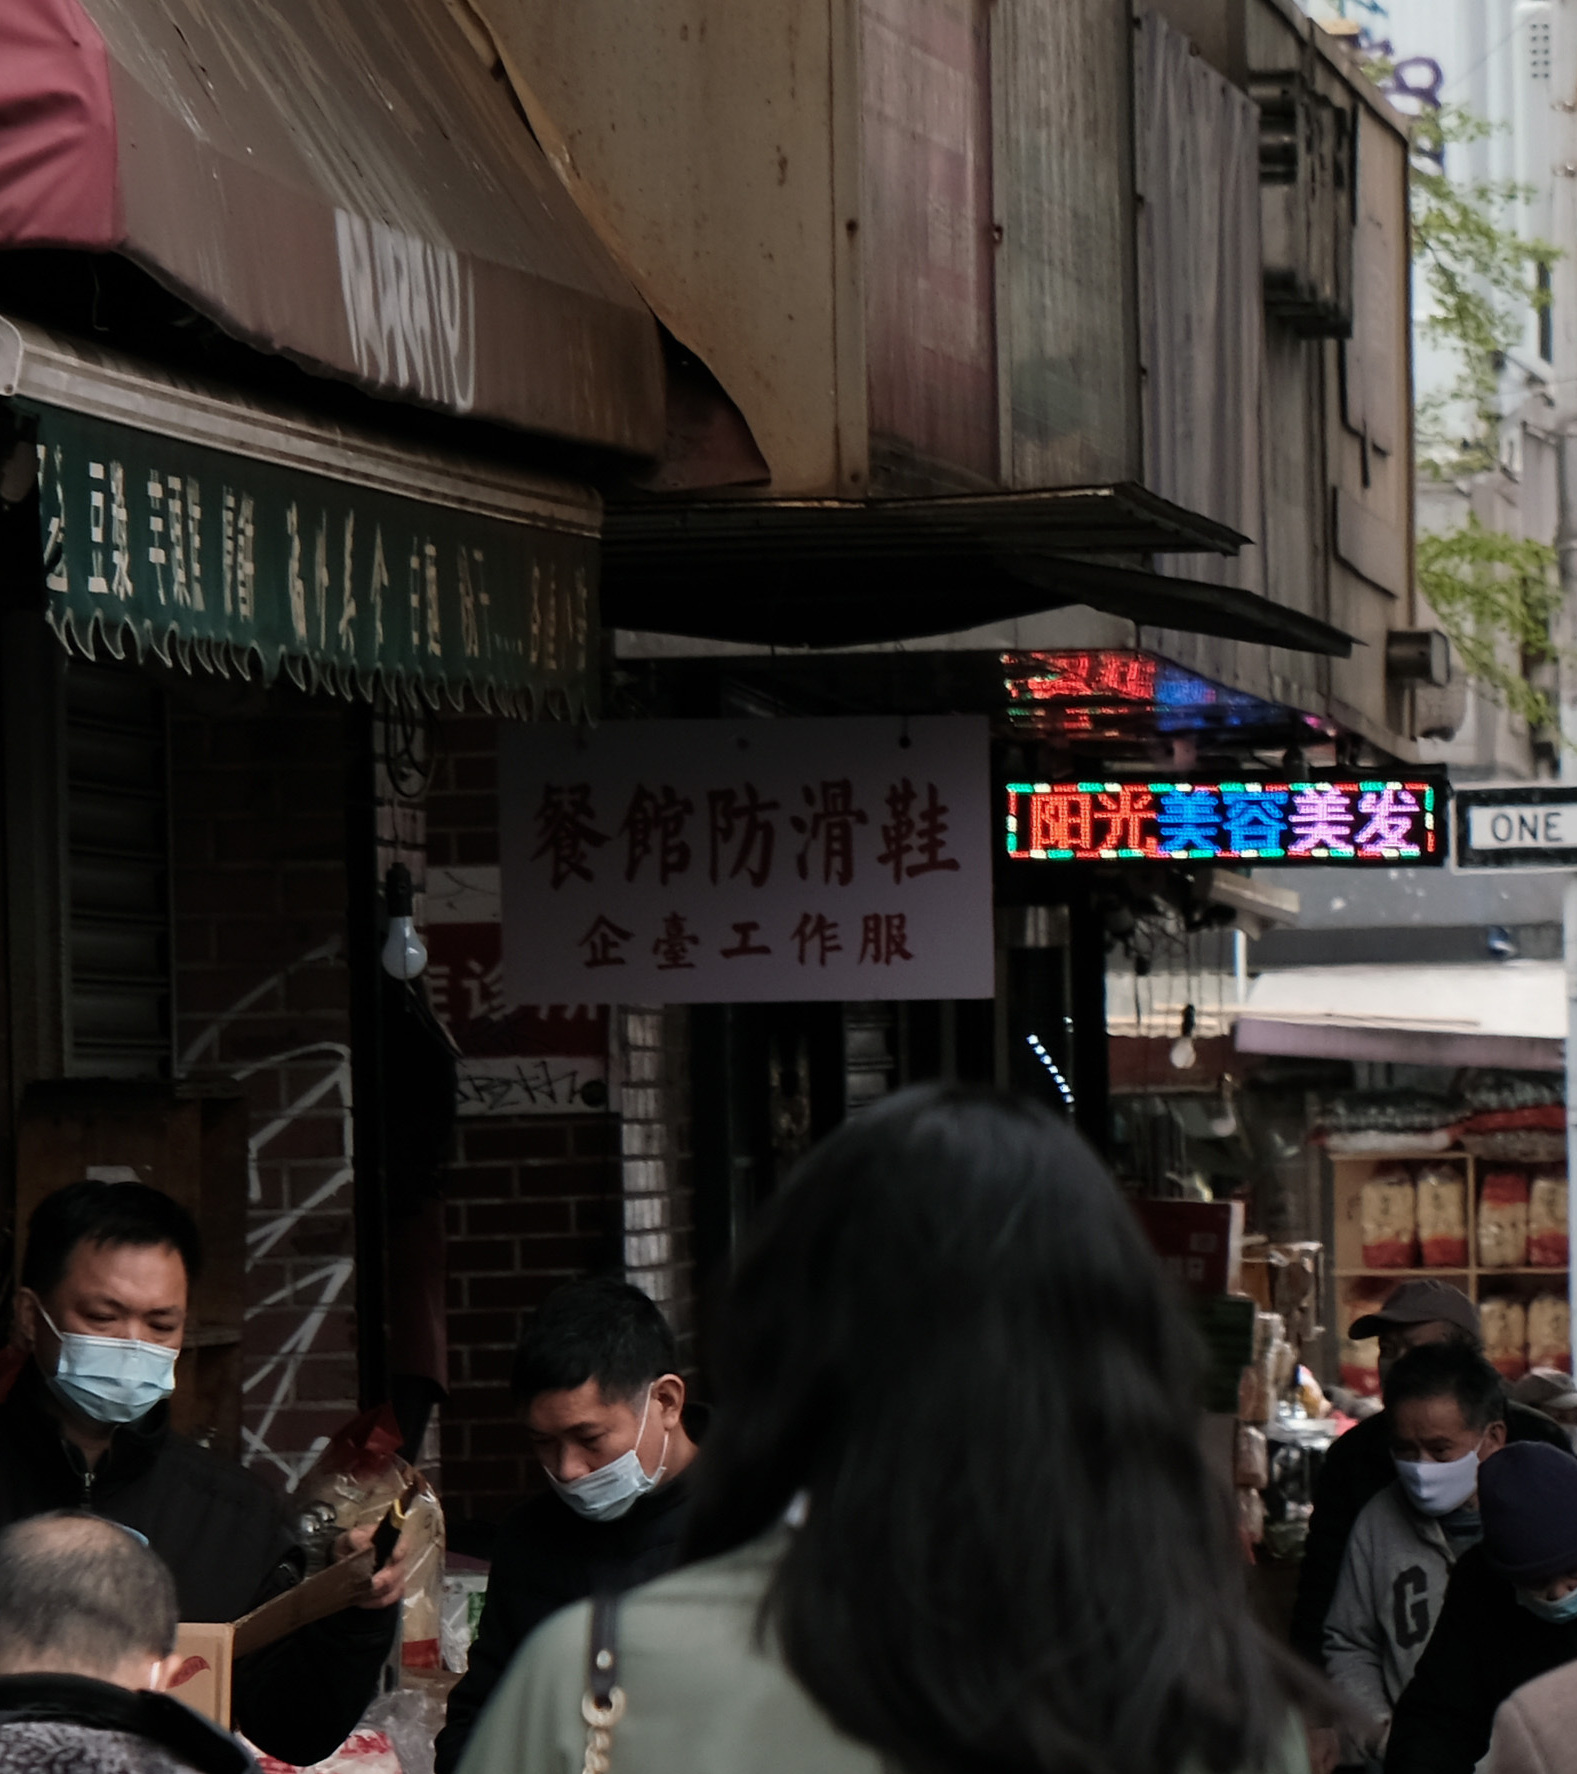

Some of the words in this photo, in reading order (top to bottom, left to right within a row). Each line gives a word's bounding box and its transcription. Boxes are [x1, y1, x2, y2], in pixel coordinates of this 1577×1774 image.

[530, 776, 961, 891] 餐館防滑鞋
[1029, 789, 1421, 855] 阳光美容美发
[1491, 811, 1564, 843] ONE
[579, 911, 915, 970] 企臺工作服
[1393, 1565, 1430, 1649] G
